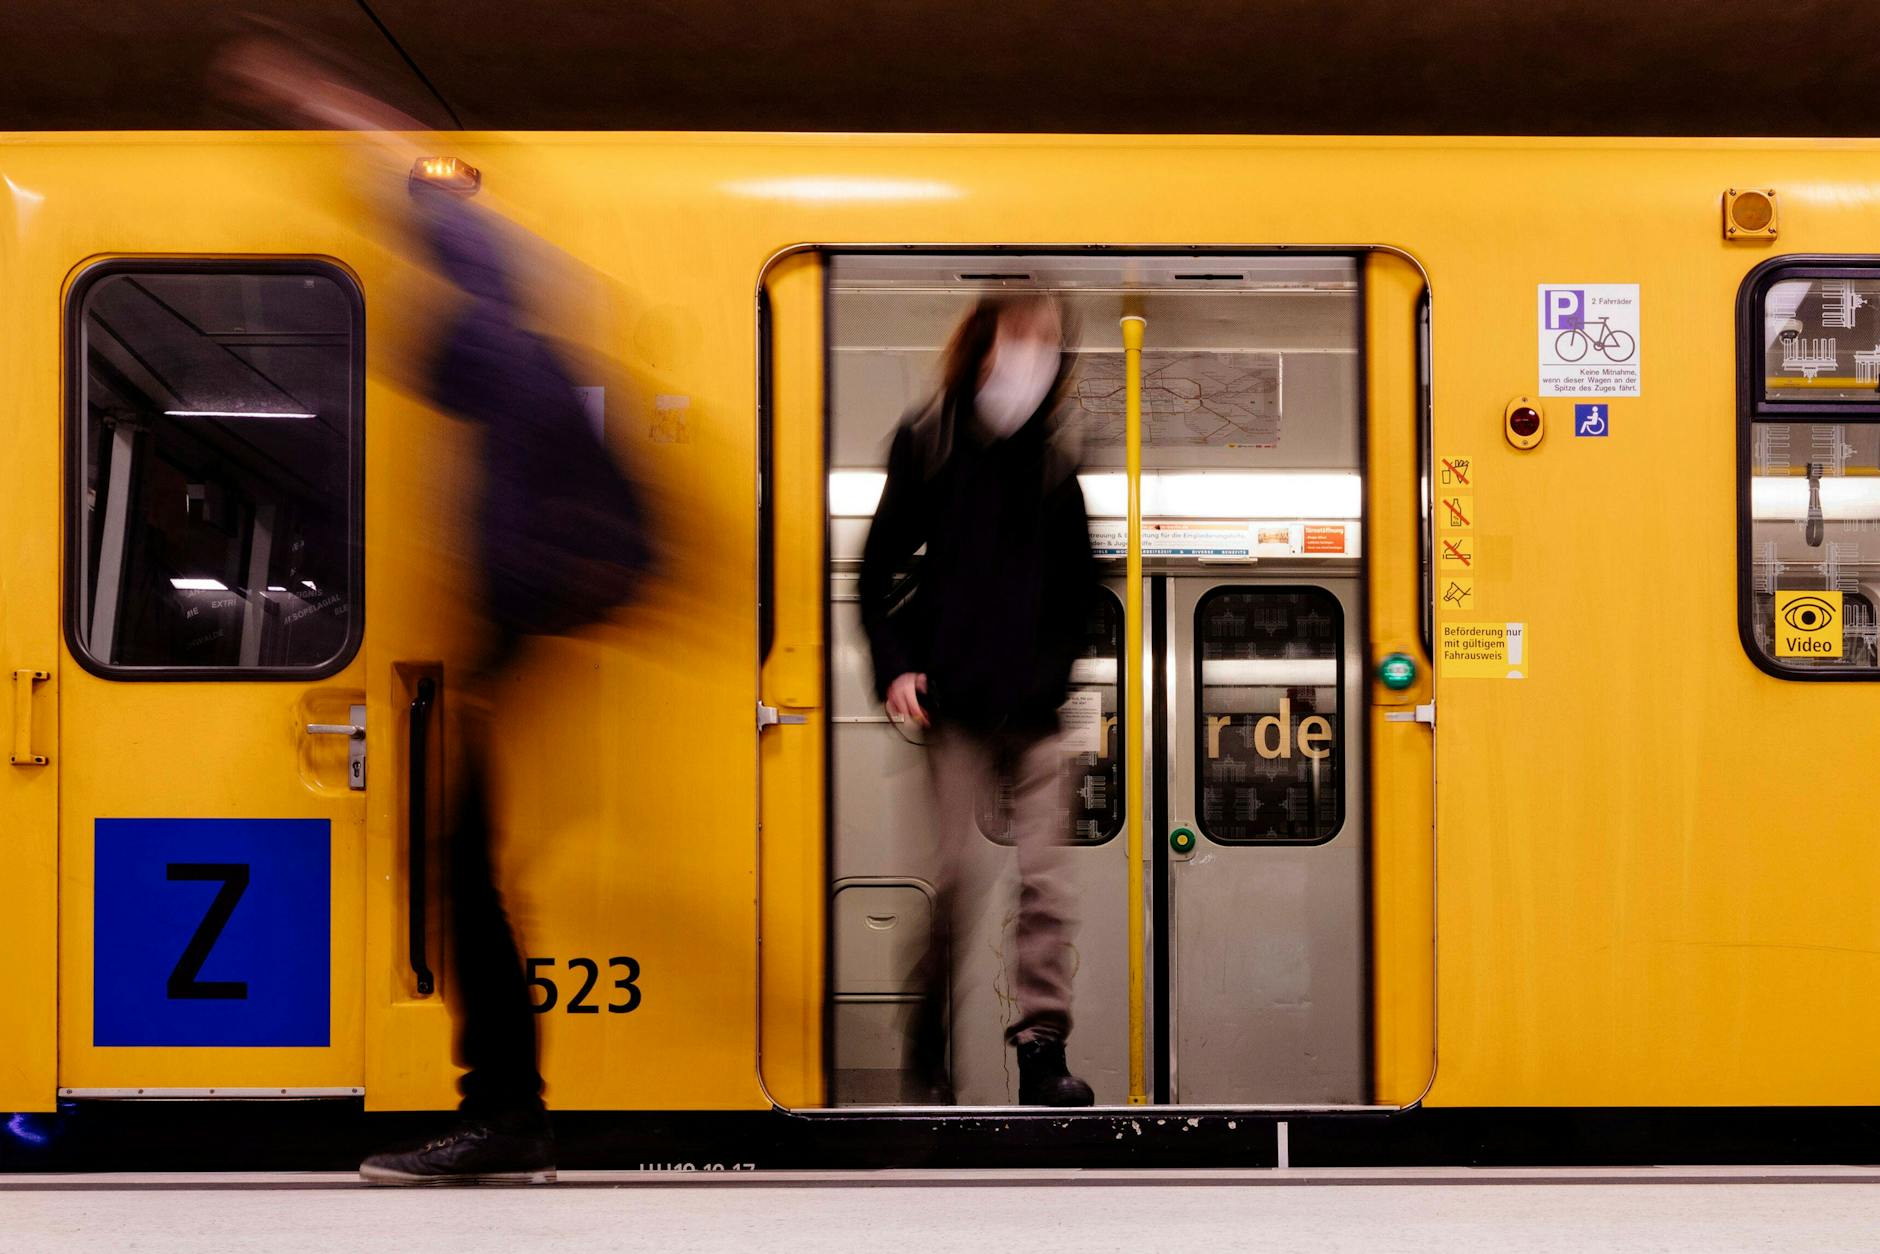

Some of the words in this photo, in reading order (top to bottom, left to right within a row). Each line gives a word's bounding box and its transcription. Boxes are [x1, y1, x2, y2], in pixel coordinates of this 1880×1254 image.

[1591, 297, 1597, 305] 2
[1598, 297, 1632, 305] Fahrräder
[1550, 290, 1578, 329] P
[1588, 377, 1611, 385] Wagen
[1594, 385, 1616, 393] Zuges
[1444, 626, 1503, 638] Beförderung
[1444, 638, 1460, 648] mit
[1462, 638, 1505, 649] gültigem
[1786, 636, 1832, 652] Video
[1444, 650, 1502, 660] Fahrausweis
[1254, 697, 1333, 760] de
[166, 863, 250, 1000] Z
[526, 956, 642, 1014] 523
